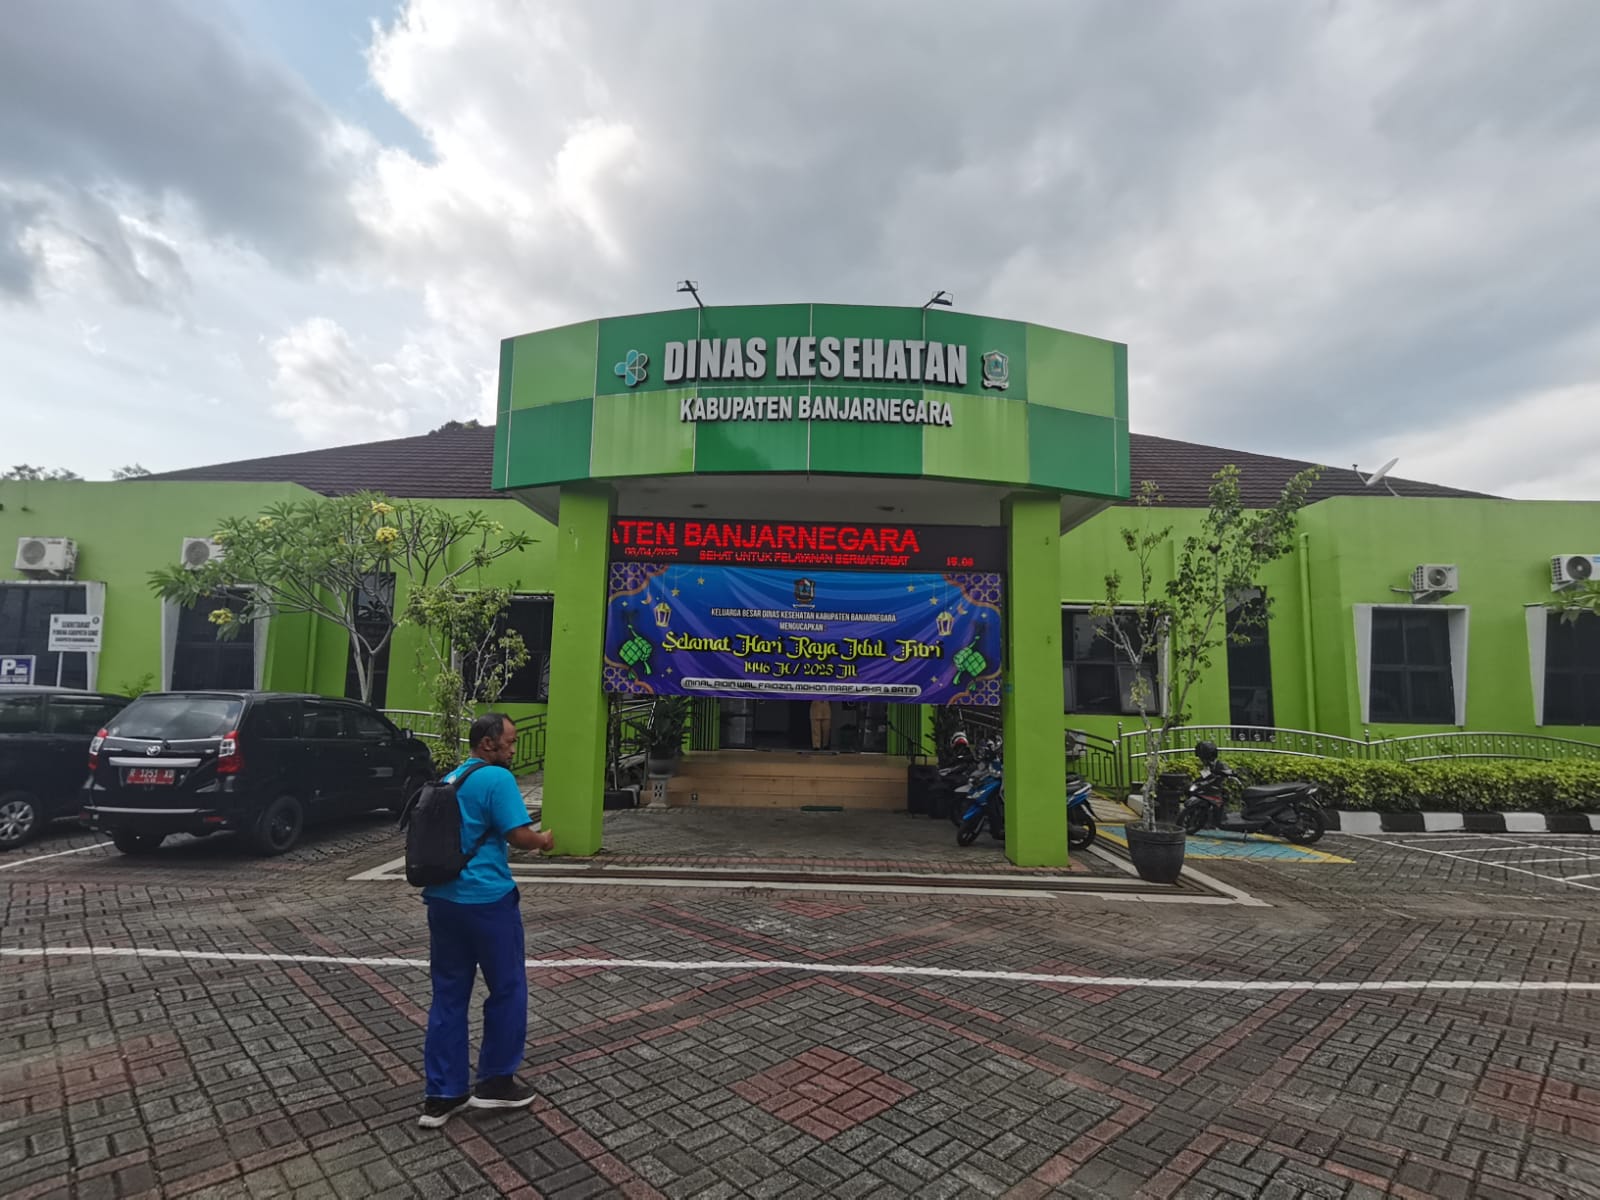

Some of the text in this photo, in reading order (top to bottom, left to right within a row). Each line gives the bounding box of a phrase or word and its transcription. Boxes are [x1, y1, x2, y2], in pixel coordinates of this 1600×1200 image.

[663, 336, 968, 385] DINAS KESEHATAN
[679, 395, 954, 426] KABUPATEN BANJARNEGARA
[683, 523, 921, 553] BANJARNEGARA
[711, 607, 897, 623] KELUARGA BESAR DINAS KESEHATAN KABUPATEN BANJARNEGARA
[661, 631, 731, 652] Selamat
[732, 634, 782, 657] Hari
[785, 636, 839, 661] Raya
[892, 639, 942, 662] Fitri
[1, 659, 17, 675] P
[744, 661, 771, 674] 1446
[803, 663, 835, 676] 2025
[795, 683, 827, 691] MOHON
